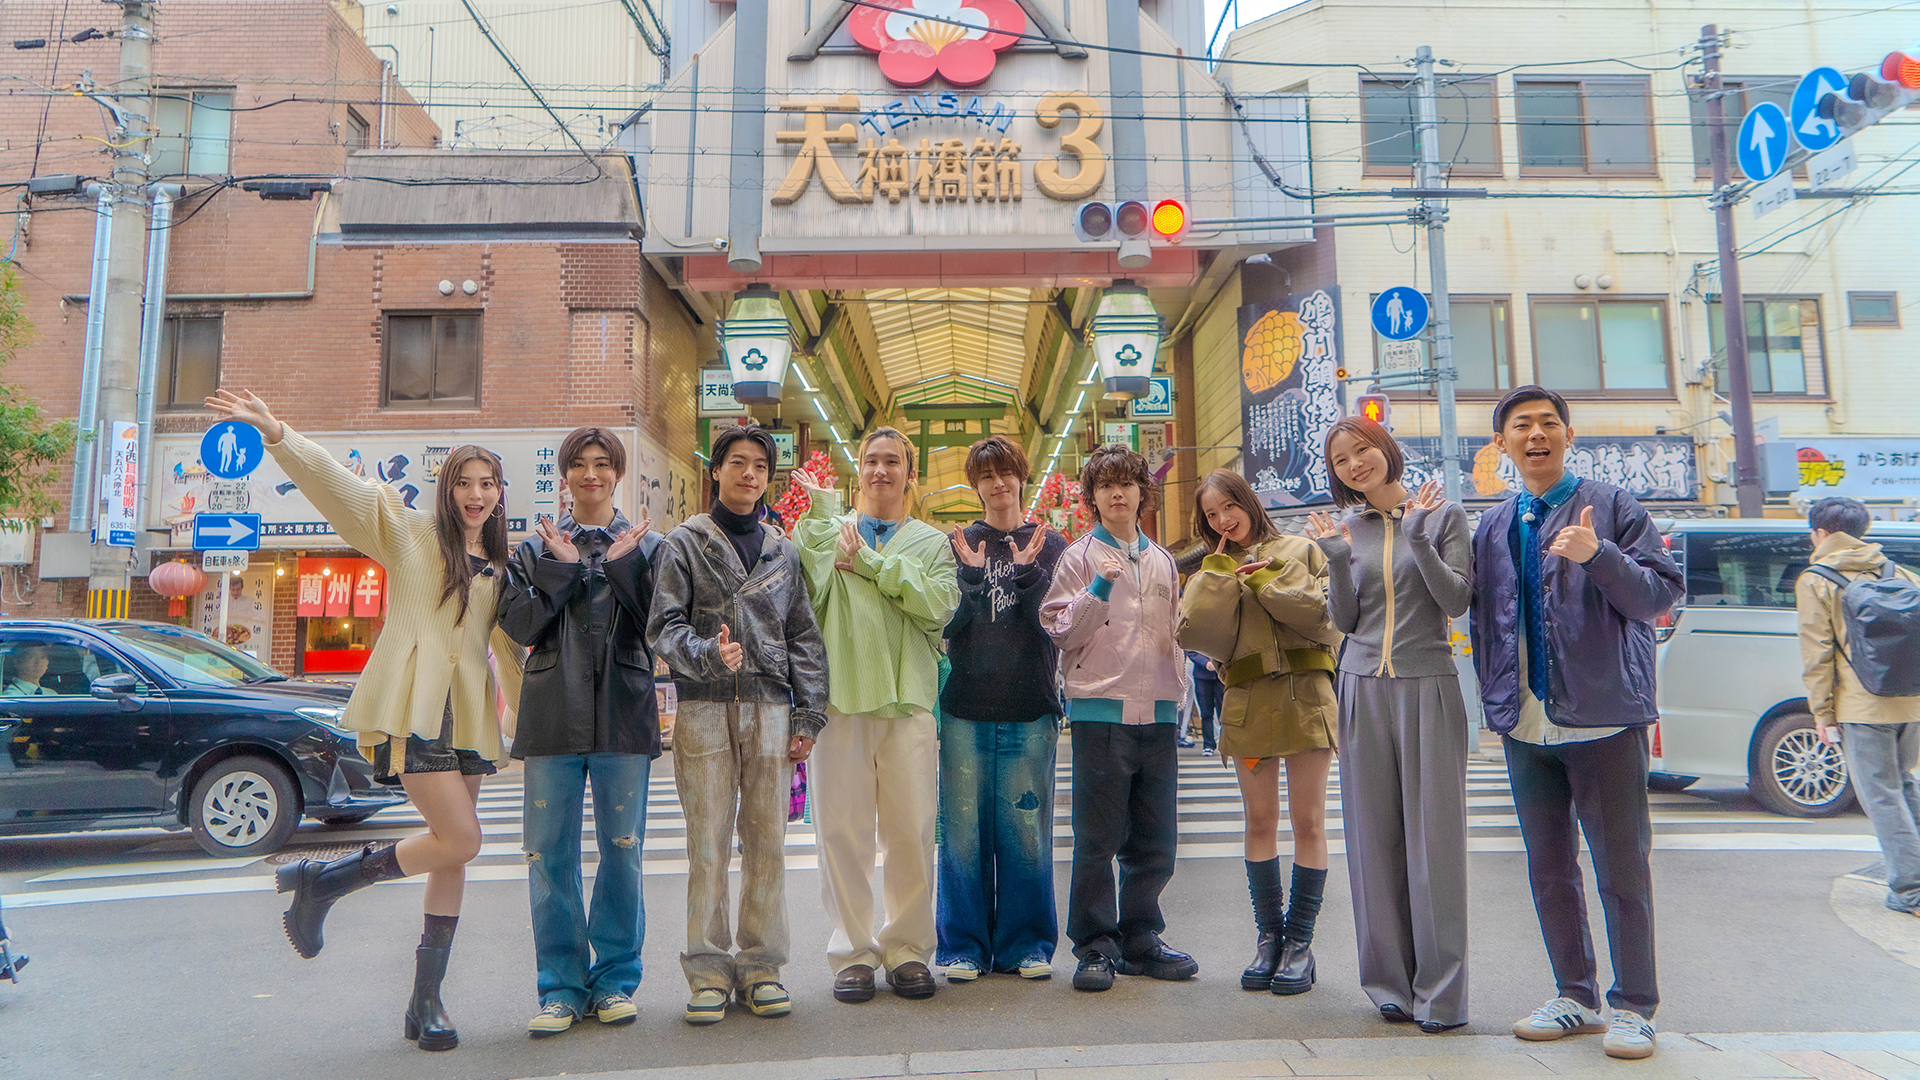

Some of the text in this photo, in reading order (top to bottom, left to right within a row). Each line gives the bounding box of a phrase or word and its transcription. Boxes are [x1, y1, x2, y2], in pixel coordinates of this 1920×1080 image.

[858, 91, 1017, 137] TENSAN
[205, 555, 246, 567] 自転車を除く
[299, 573, 381, 605] 蘭州牛
